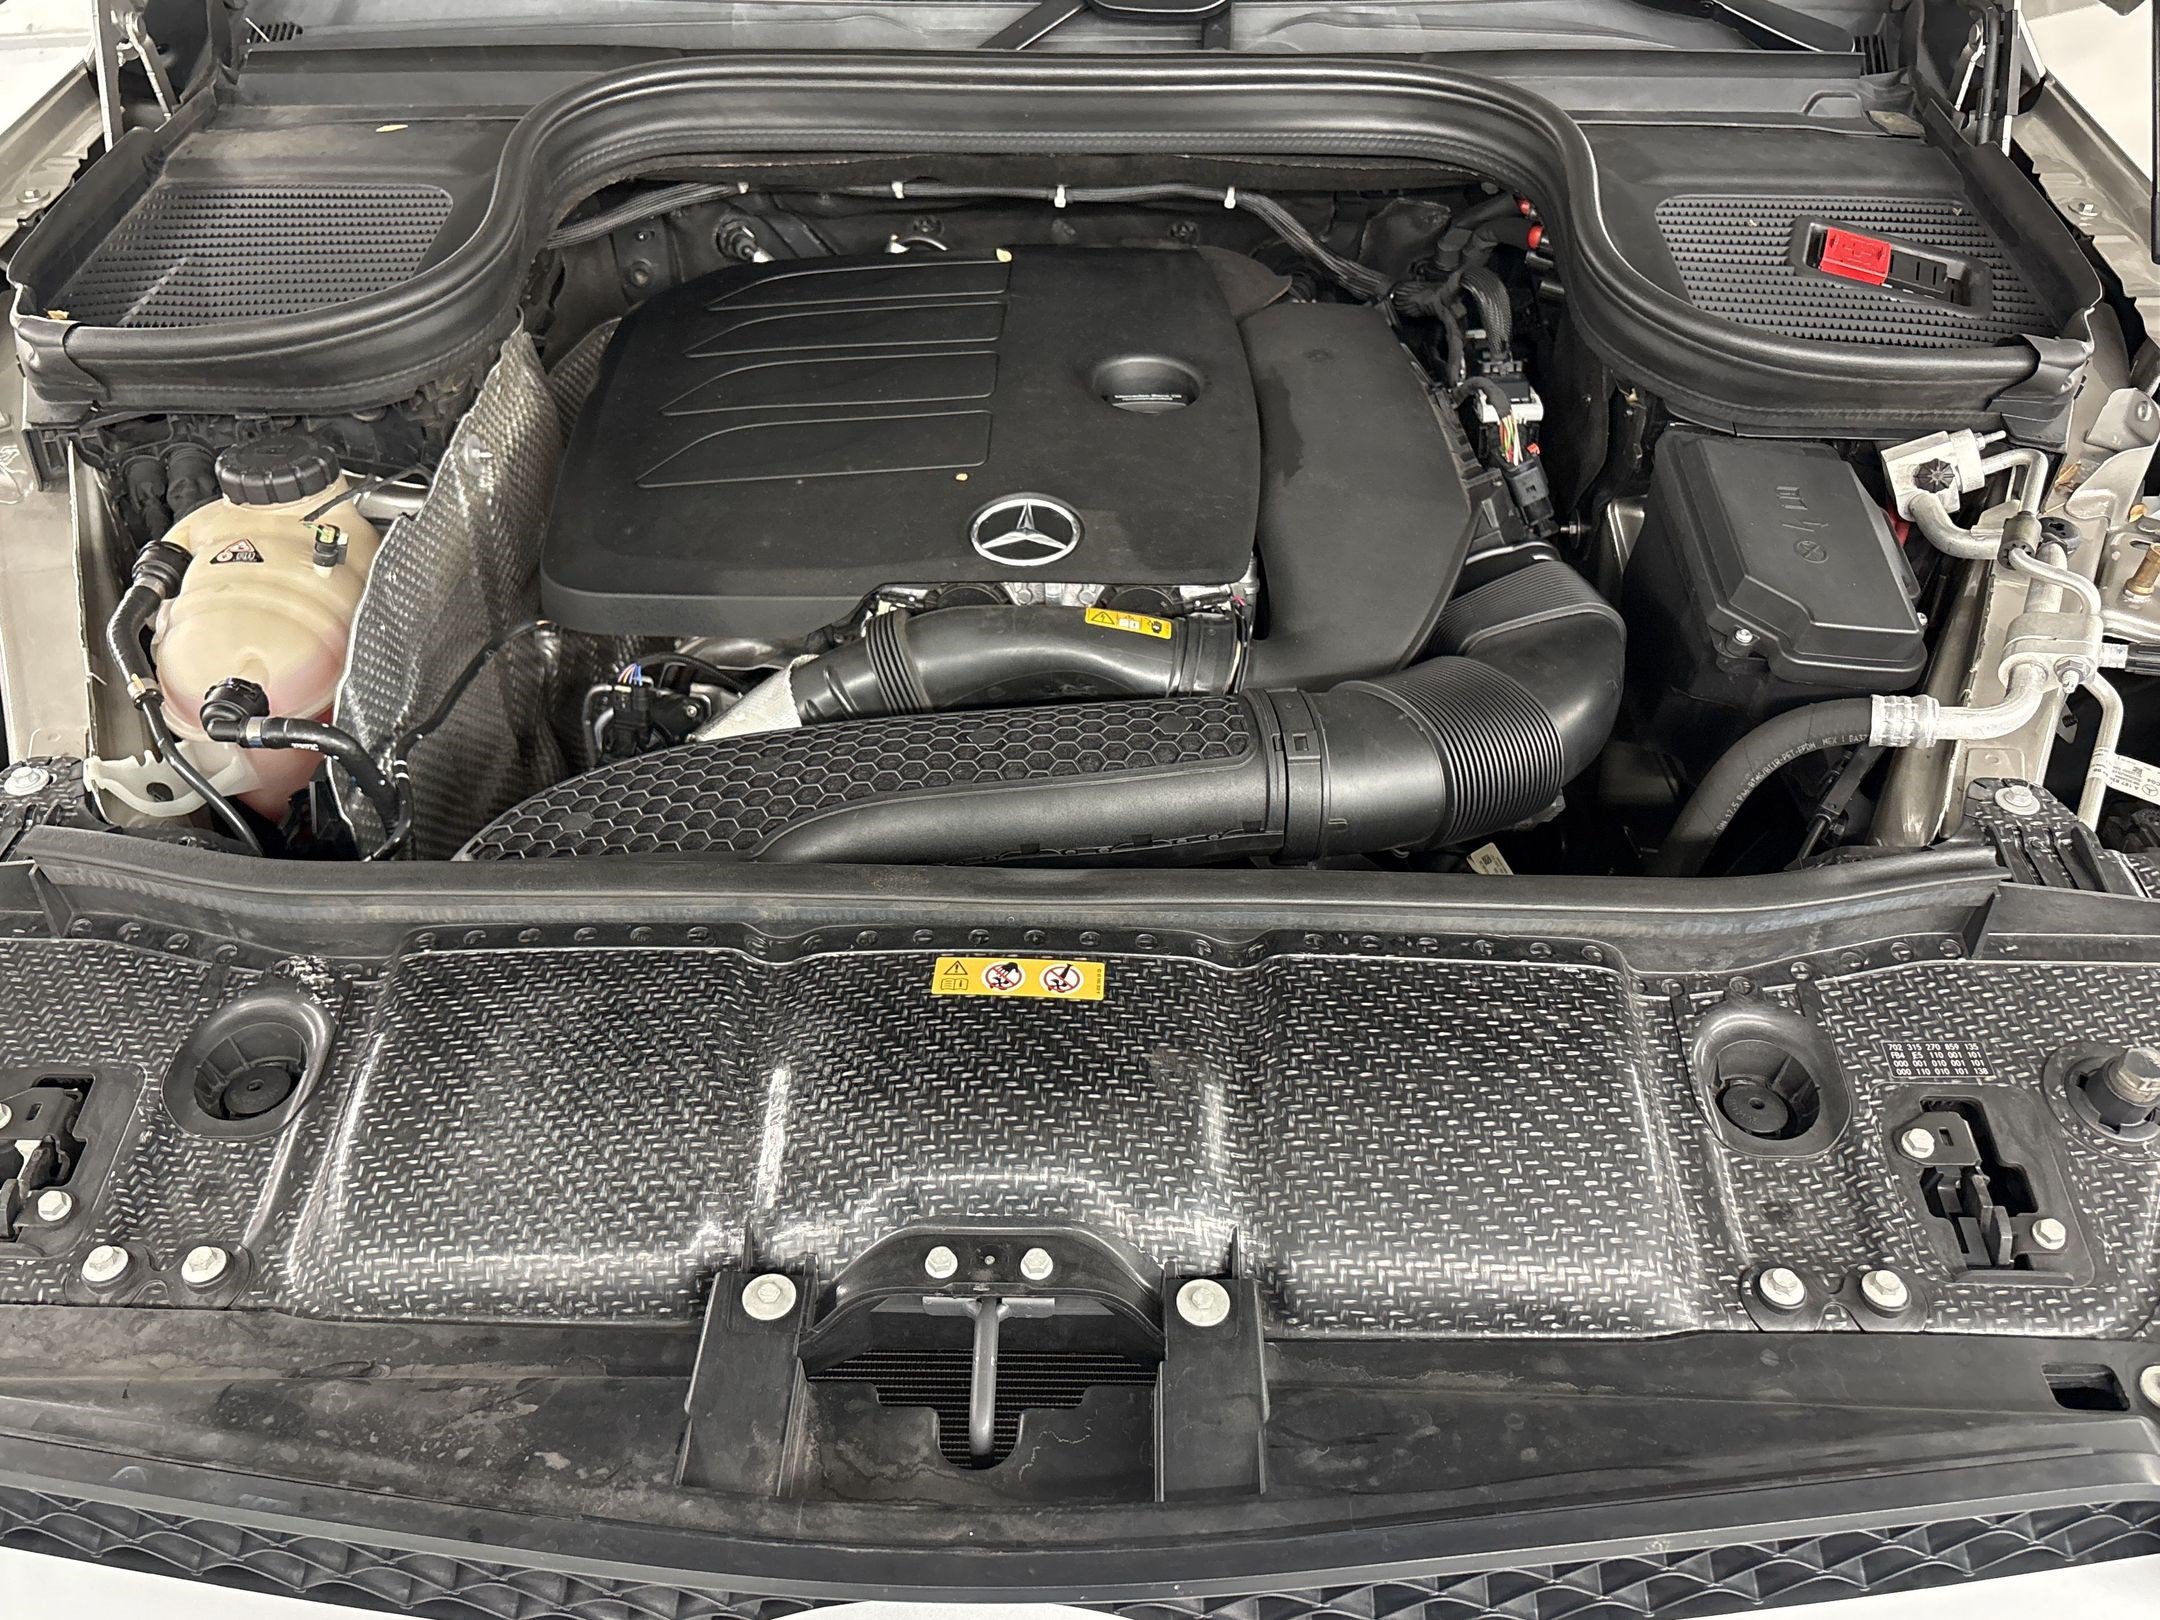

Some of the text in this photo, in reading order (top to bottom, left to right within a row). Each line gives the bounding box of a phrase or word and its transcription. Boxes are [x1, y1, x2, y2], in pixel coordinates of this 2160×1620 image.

[1887, 1043, 1979, 1051] 702 315 270 859 135
[1929, 1051, 1944, 1059] 110
[1947, 1051, 1962, 1059] 001
[1967, 1051, 1981, 1059] 101
